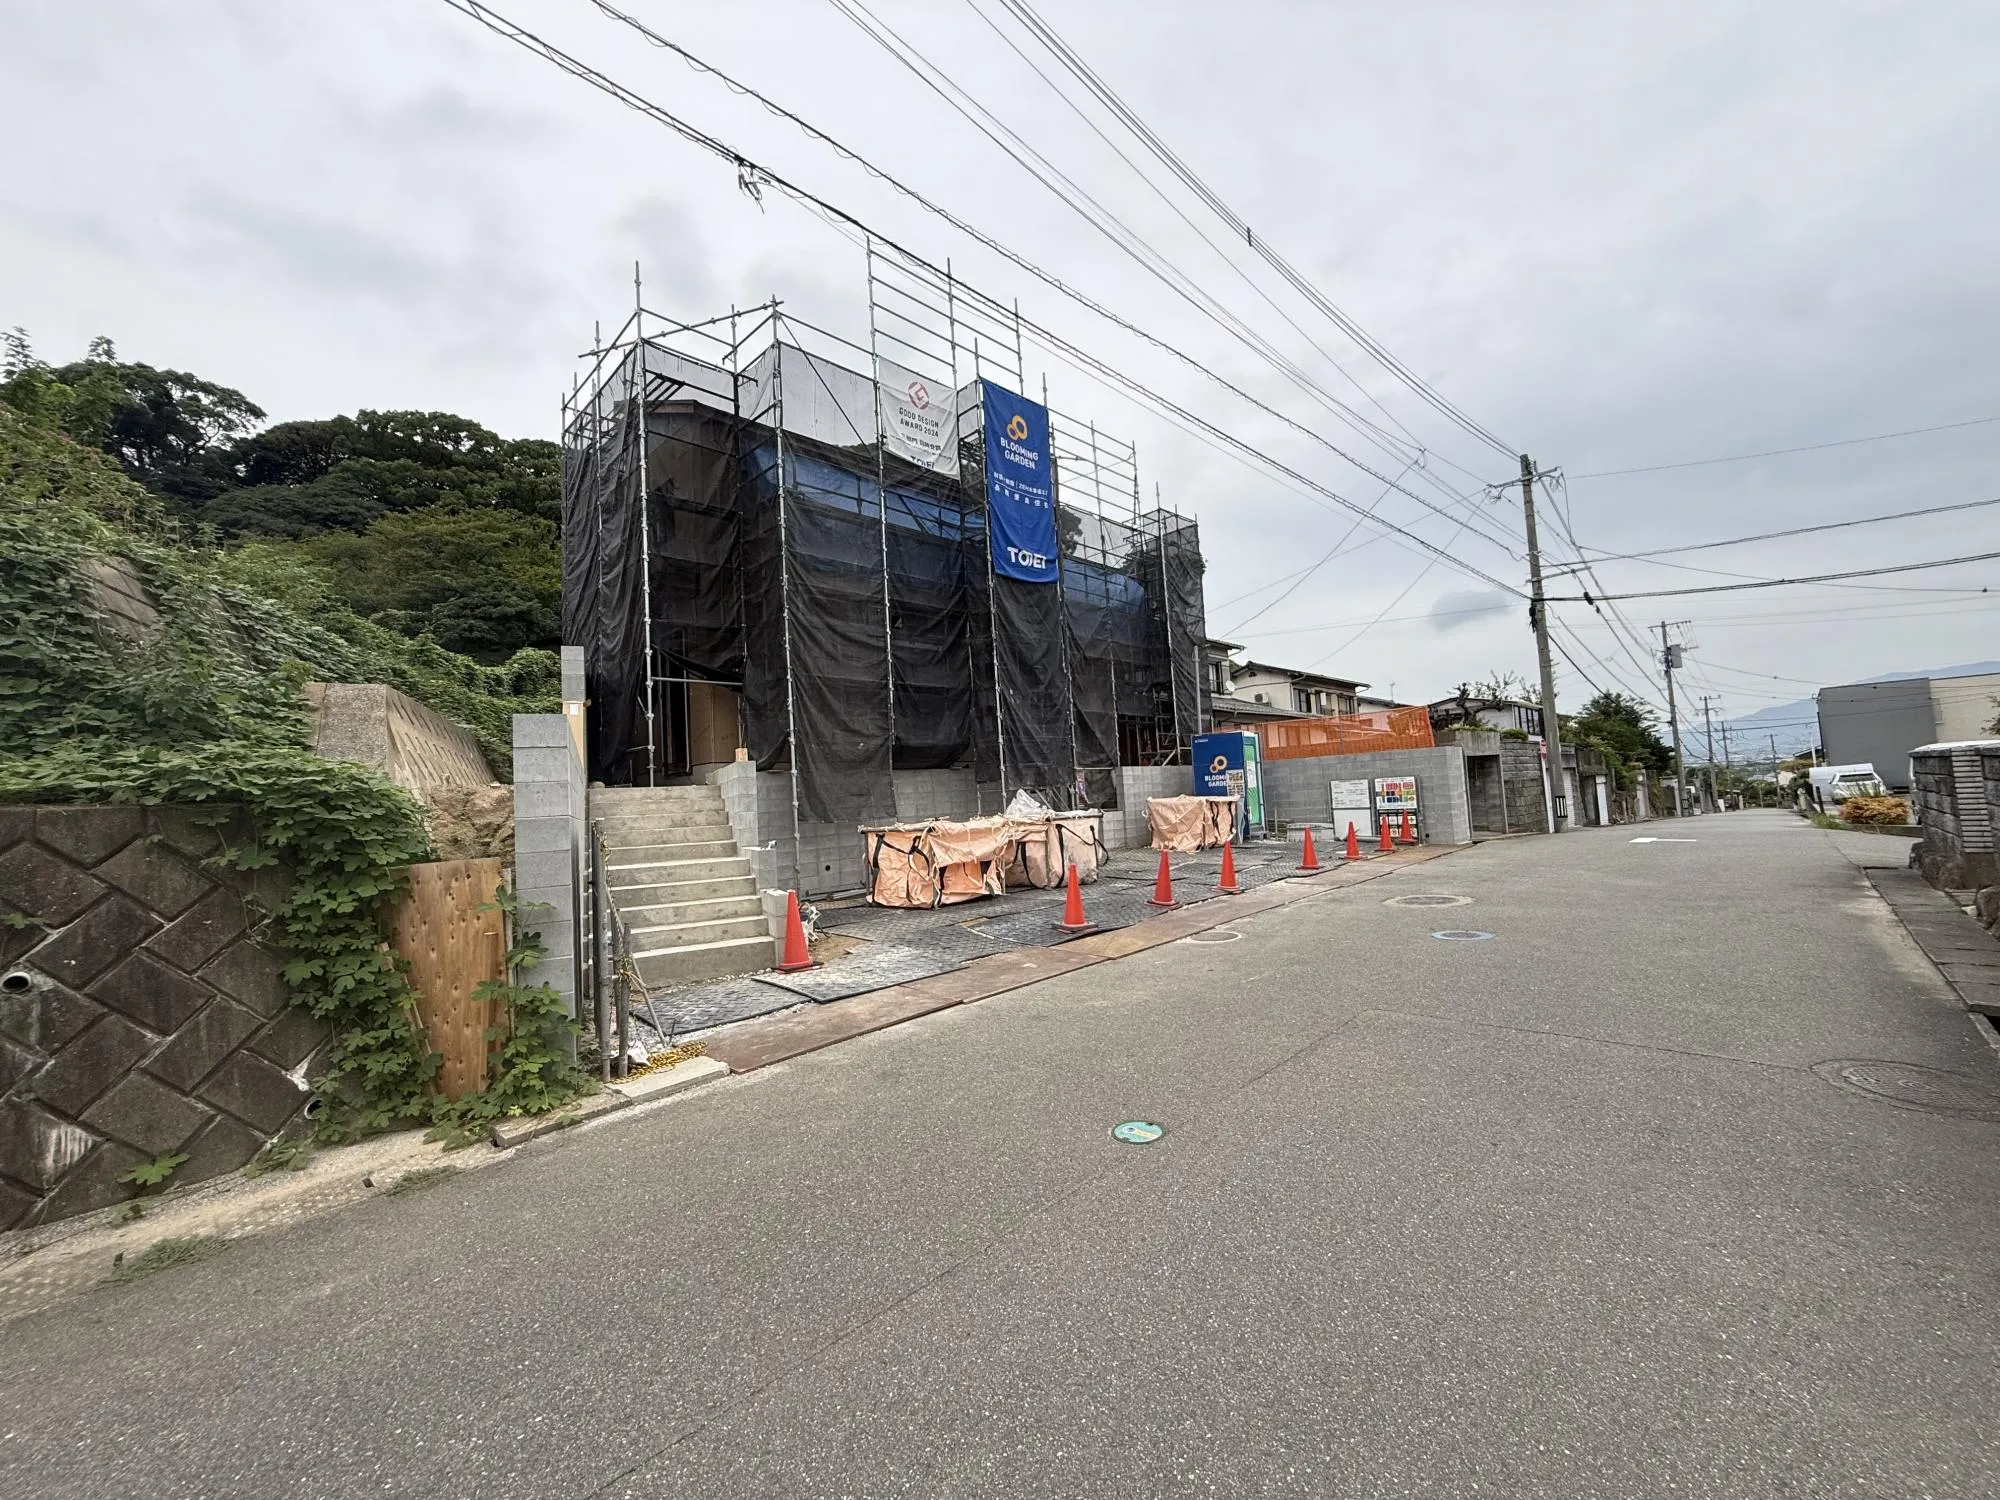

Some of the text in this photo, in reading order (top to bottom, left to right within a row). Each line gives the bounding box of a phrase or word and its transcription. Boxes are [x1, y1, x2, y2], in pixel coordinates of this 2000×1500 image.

[899, 407, 939, 428] GOOD DESIGN
[900, 418, 939, 437] AWARD 2024
[1000, 437, 1038, 460] BLOOMING
[1005, 450, 1035, 469] GARDEN
